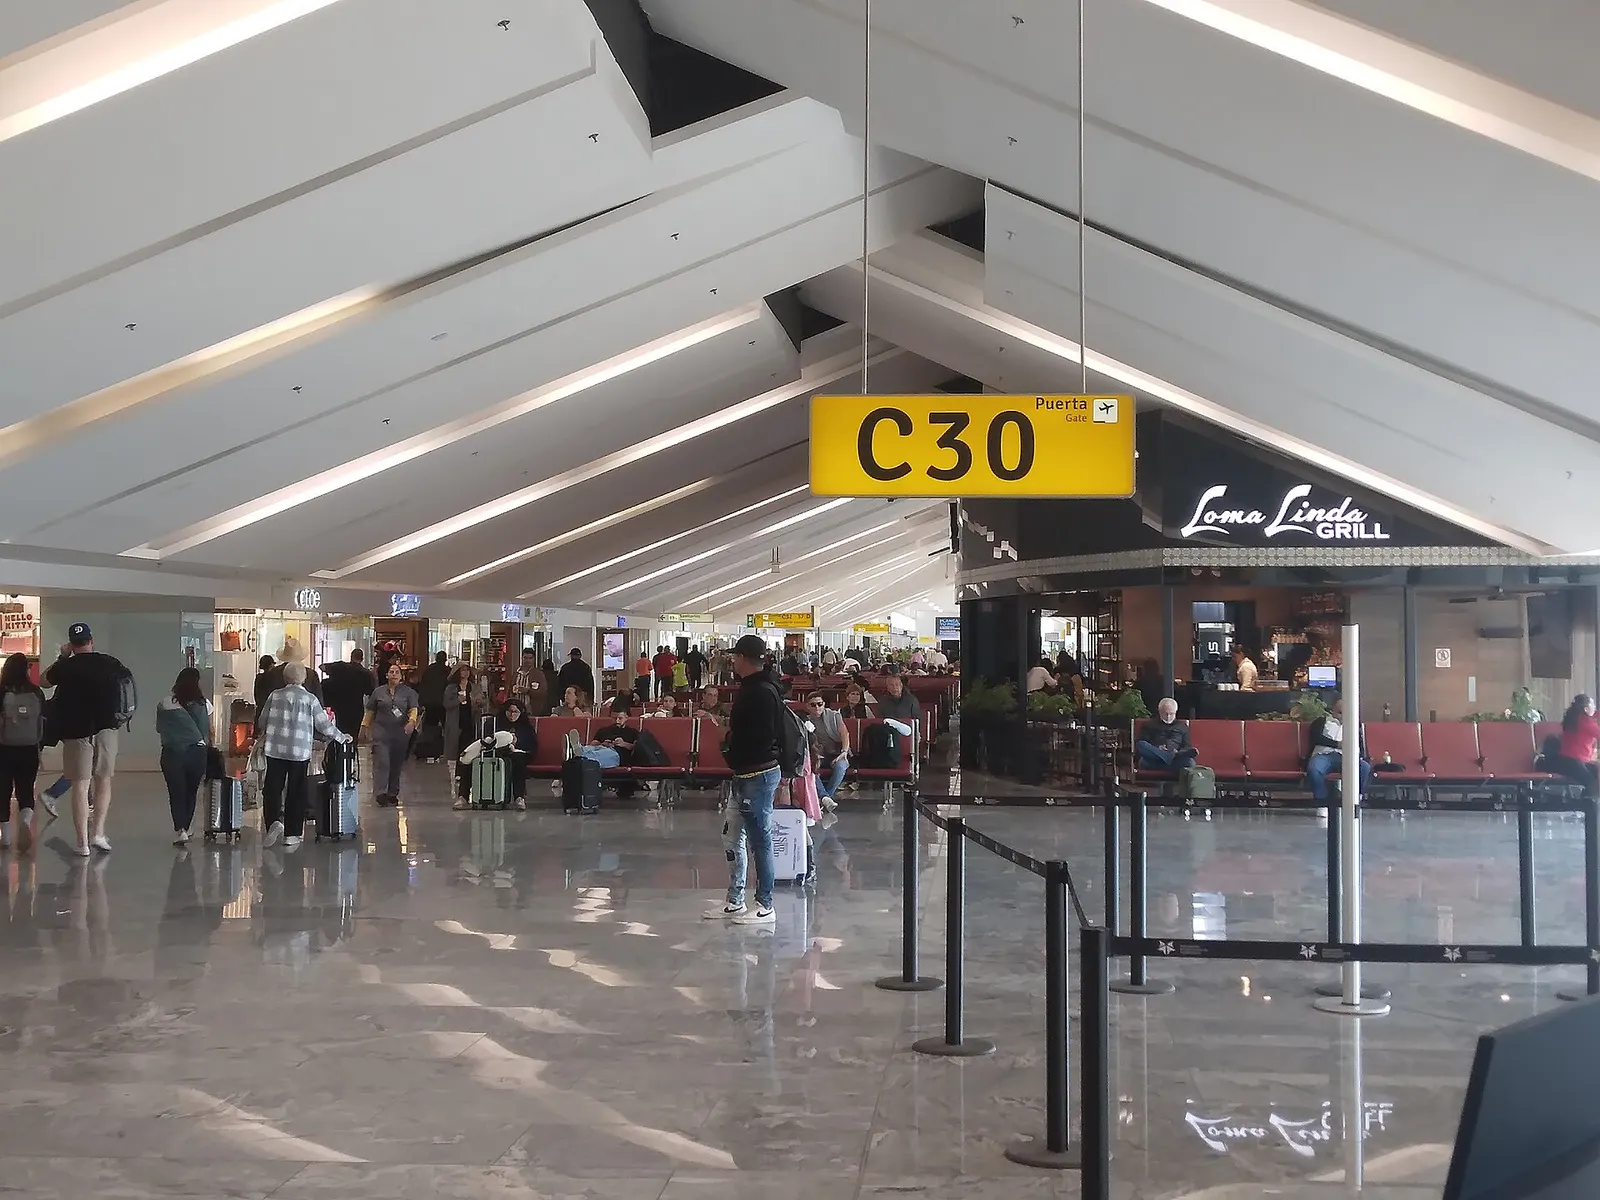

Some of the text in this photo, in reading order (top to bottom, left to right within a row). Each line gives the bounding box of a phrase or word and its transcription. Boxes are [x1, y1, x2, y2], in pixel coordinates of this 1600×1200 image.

[1036, 397, 1087, 410] Puerta
[1065, 413, 1087, 423] Gate
[857, 407, 1036, 481] C30
[1180, 484, 1367, 539] Loma Linda
[1316, 522, 1390, 539] GRILL
